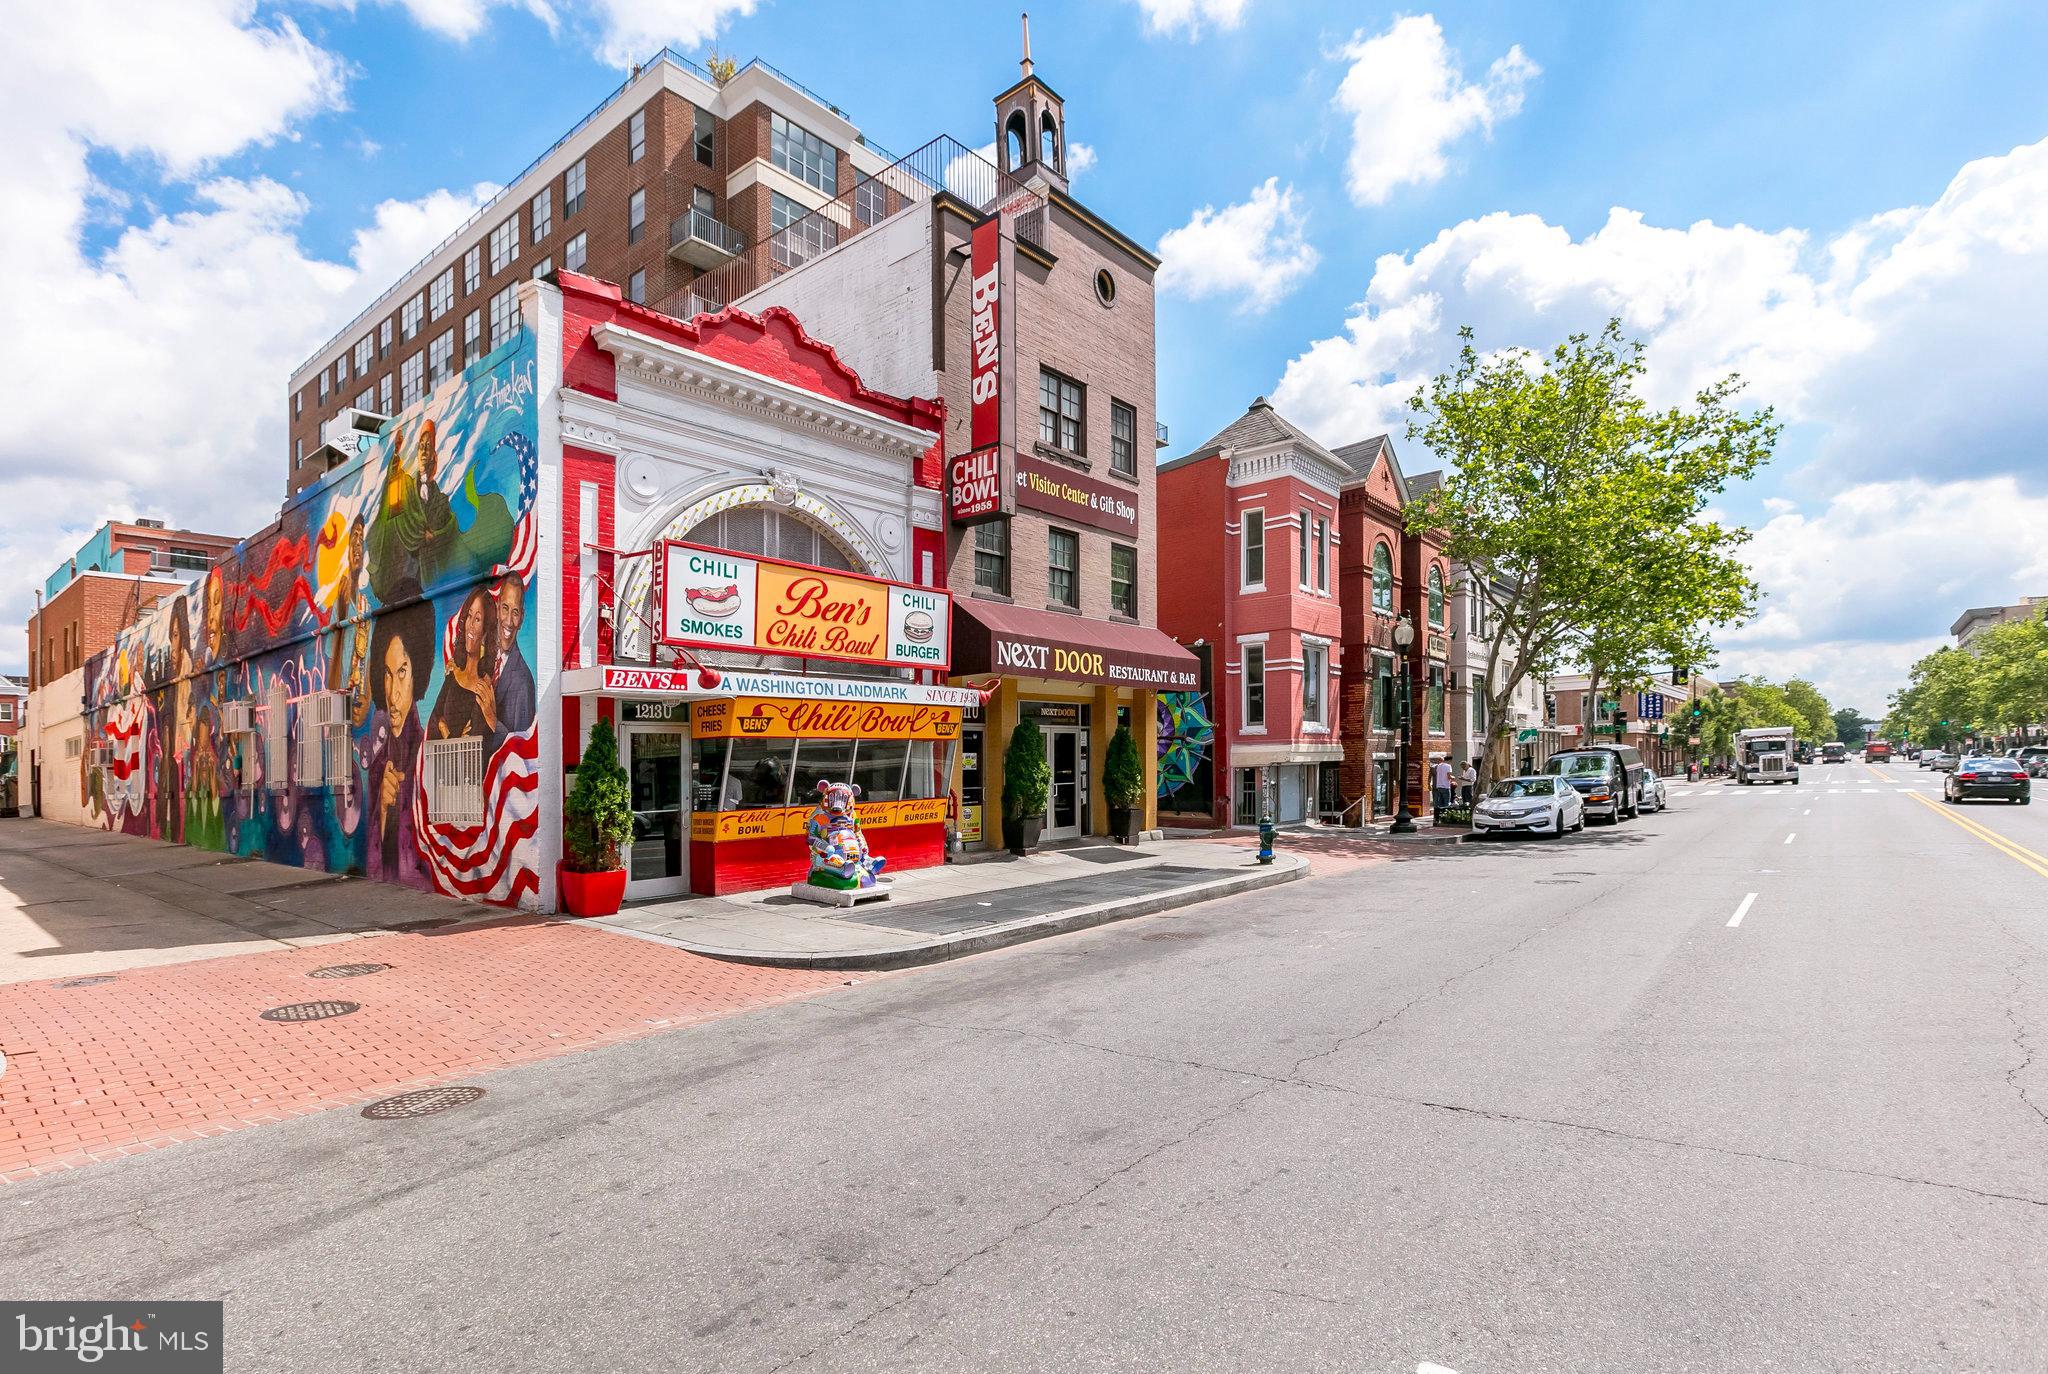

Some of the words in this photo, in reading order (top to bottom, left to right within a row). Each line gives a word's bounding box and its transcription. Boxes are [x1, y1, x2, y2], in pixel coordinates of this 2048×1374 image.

[973, 261, 998, 405] BEN'S
[952, 452, 998, 485] CHILI
[952, 476, 999, 506] BOWL
[1029, 472, 1060, 498] Visitor
[1061, 483, 1090, 507] Center
[1090, 492, 1099, 510] &
[1100, 495, 1115, 514] Gift
[1116, 500, 1136, 525] Shop
[970, 500, 993, 513] 1958
[689, 556, 738, 579] CHILI
[653, 541, 663, 641] BEN'S
[776, 577, 872, 626] Ben's
[902, 593, 936, 611] CHILI
[680, 618, 743, 639] SMOKES
[766, 619, 818, 649] Chili
[820, 626, 880, 655] Bowl
[895, 643, 940, 660] BURGER
[1054, 648, 1105, 676] DOOR
[1109, 664, 1168, 683] RESTAURANT
[1170, 672, 1178, 684] &
[1179, 673, 1197, 685] BAR
[721, 677, 732, 691] A
[736, 677, 834, 696] WASHINGTON
[838, 683, 908, 700] LANDMARK
[925, 689, 958, 703] SINCE
[959, 691, 978, 705] 1958
[697, 703, 727, 718] CHEESE
[787, 702, 857, 733] Chili
[860, 705, 929, 733] Bowl
[701, 719, 723, 733] FRIES
[742, 718, 768, 730] BEN'S
[936, 724, 955, 735] BEN'S
[860, 804, 887, 816] Chili
[912, 800, 936, 812] Chili
[737, 810, 771, 824] Chili
[860, 816, 888, 826] MOKES
[904, 812, 939, 822] BURGERS
[737, 825, 766, 835] BOWL
